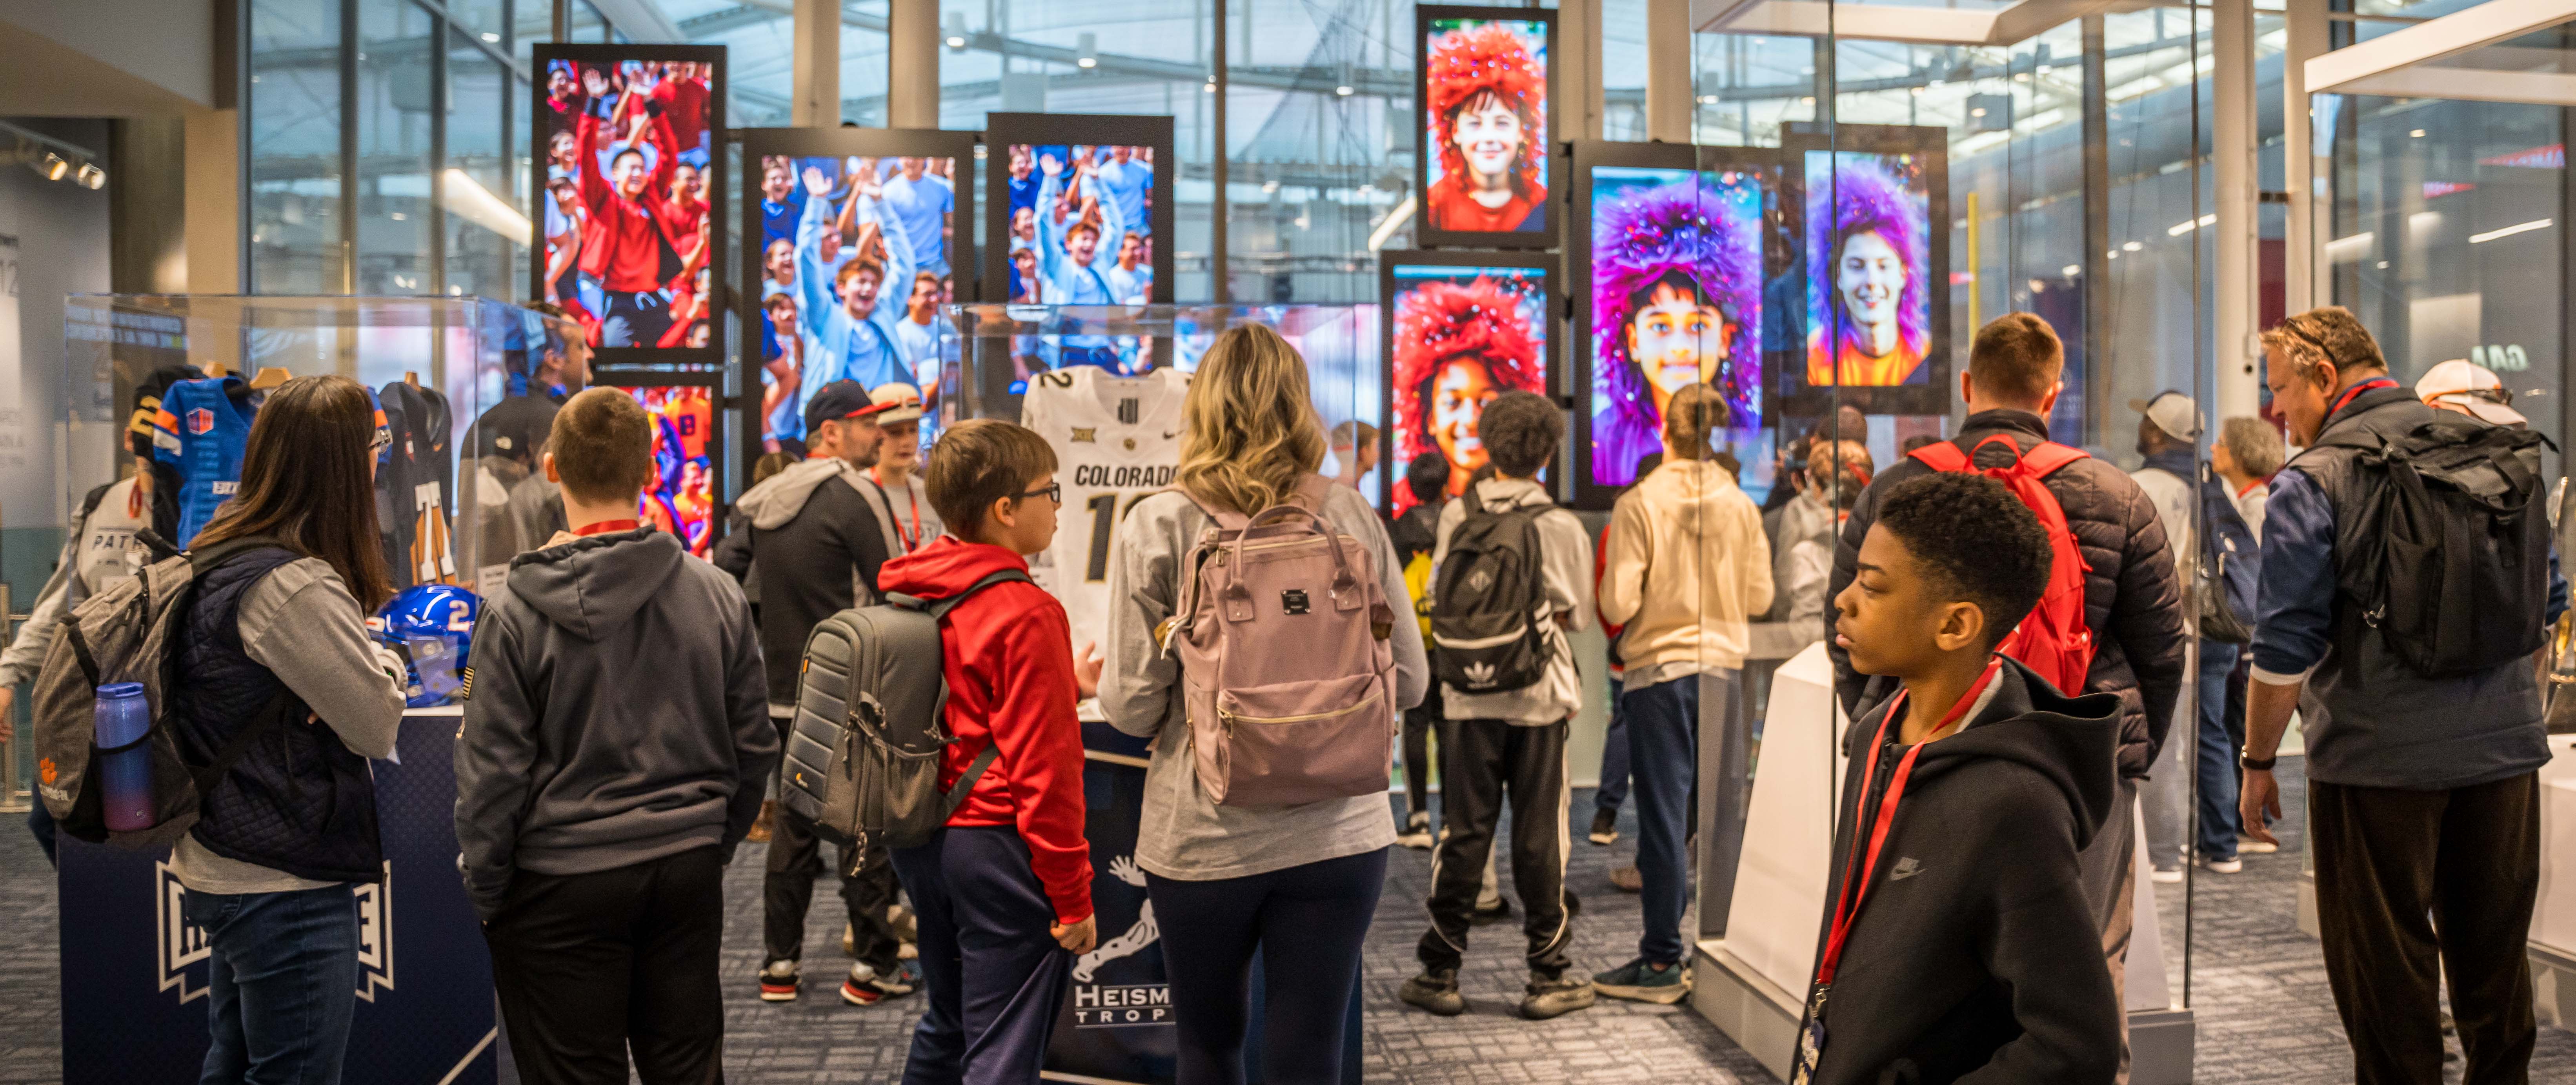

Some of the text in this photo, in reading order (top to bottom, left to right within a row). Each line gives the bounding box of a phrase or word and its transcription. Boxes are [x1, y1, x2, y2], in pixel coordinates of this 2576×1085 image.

[448, 600, 470, 632] 2
[1075, 985, 1170, 1007] HEISM
[1075, 1009, 1165, 1023] TROP
